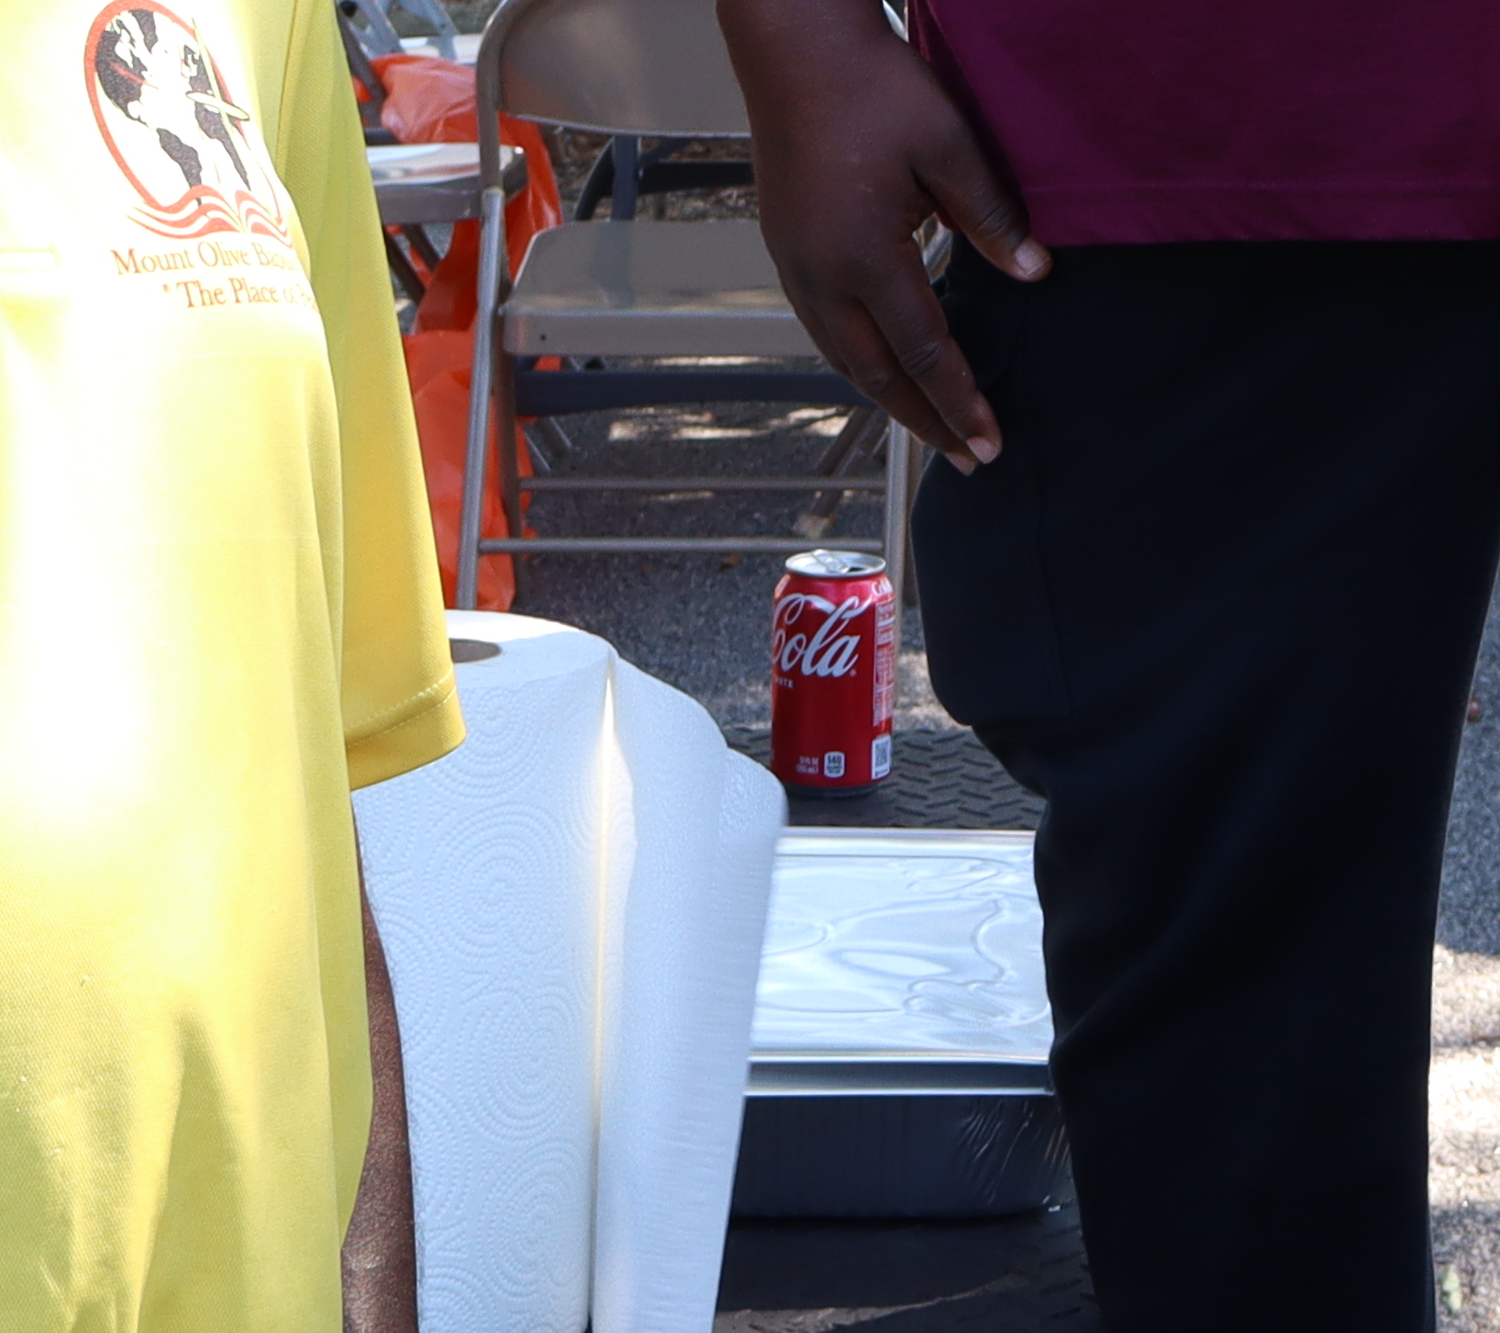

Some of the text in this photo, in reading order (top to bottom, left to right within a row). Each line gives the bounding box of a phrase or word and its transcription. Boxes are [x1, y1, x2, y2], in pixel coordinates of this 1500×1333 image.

[109, 247, 195, 276] Mount
[197, 240, 252, 268] Olive
[228, 276, 280, 305] Place
[772, 593, 872, 678] Cola
